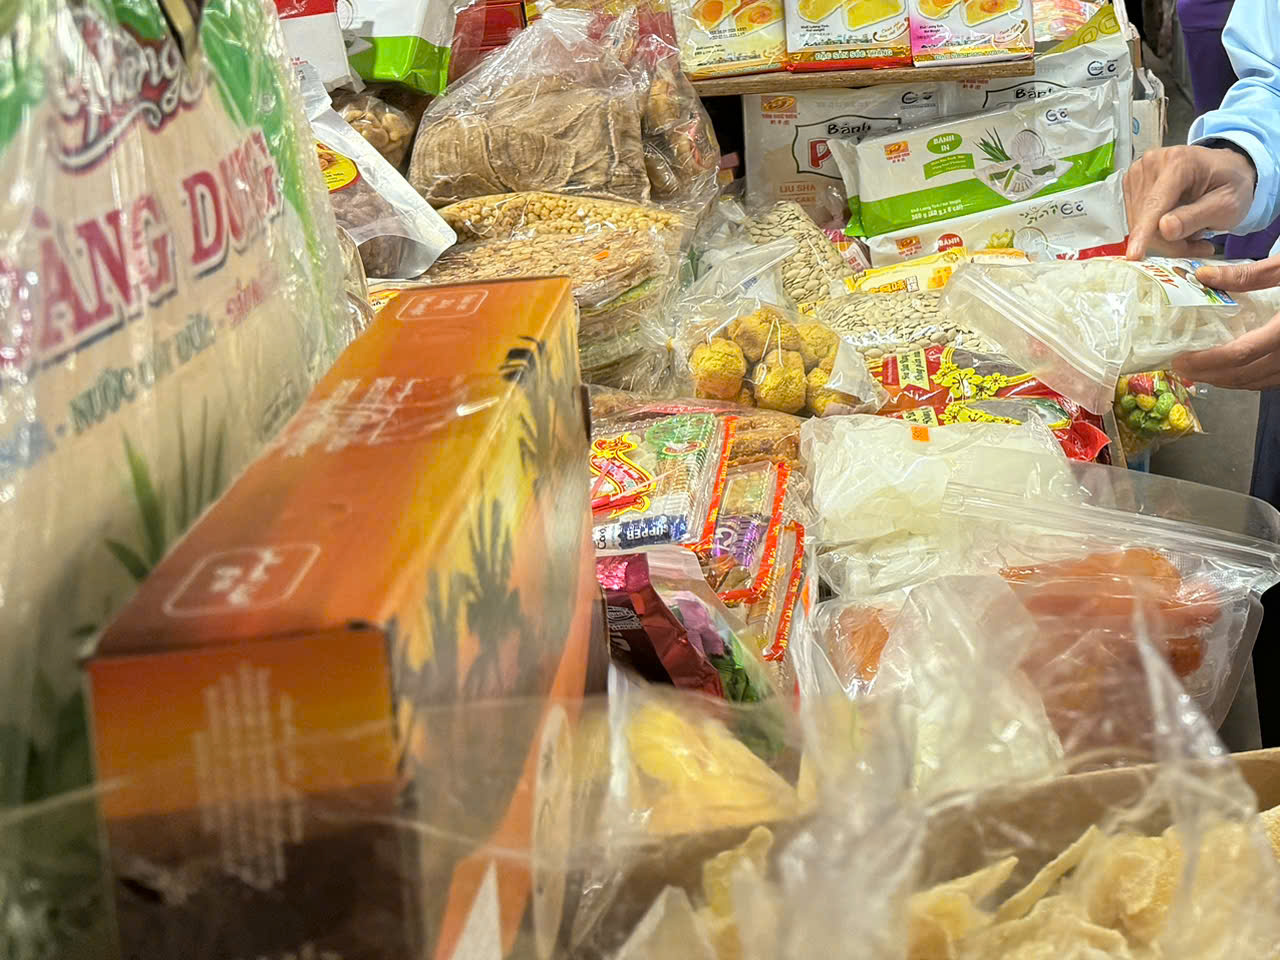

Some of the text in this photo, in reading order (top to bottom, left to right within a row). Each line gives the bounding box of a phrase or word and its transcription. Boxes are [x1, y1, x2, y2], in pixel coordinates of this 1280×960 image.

[827, 122, 871, 135] Bánh
[941, 144, 950, 152] IN
[779, 184, 817, 193] LIU SHA
